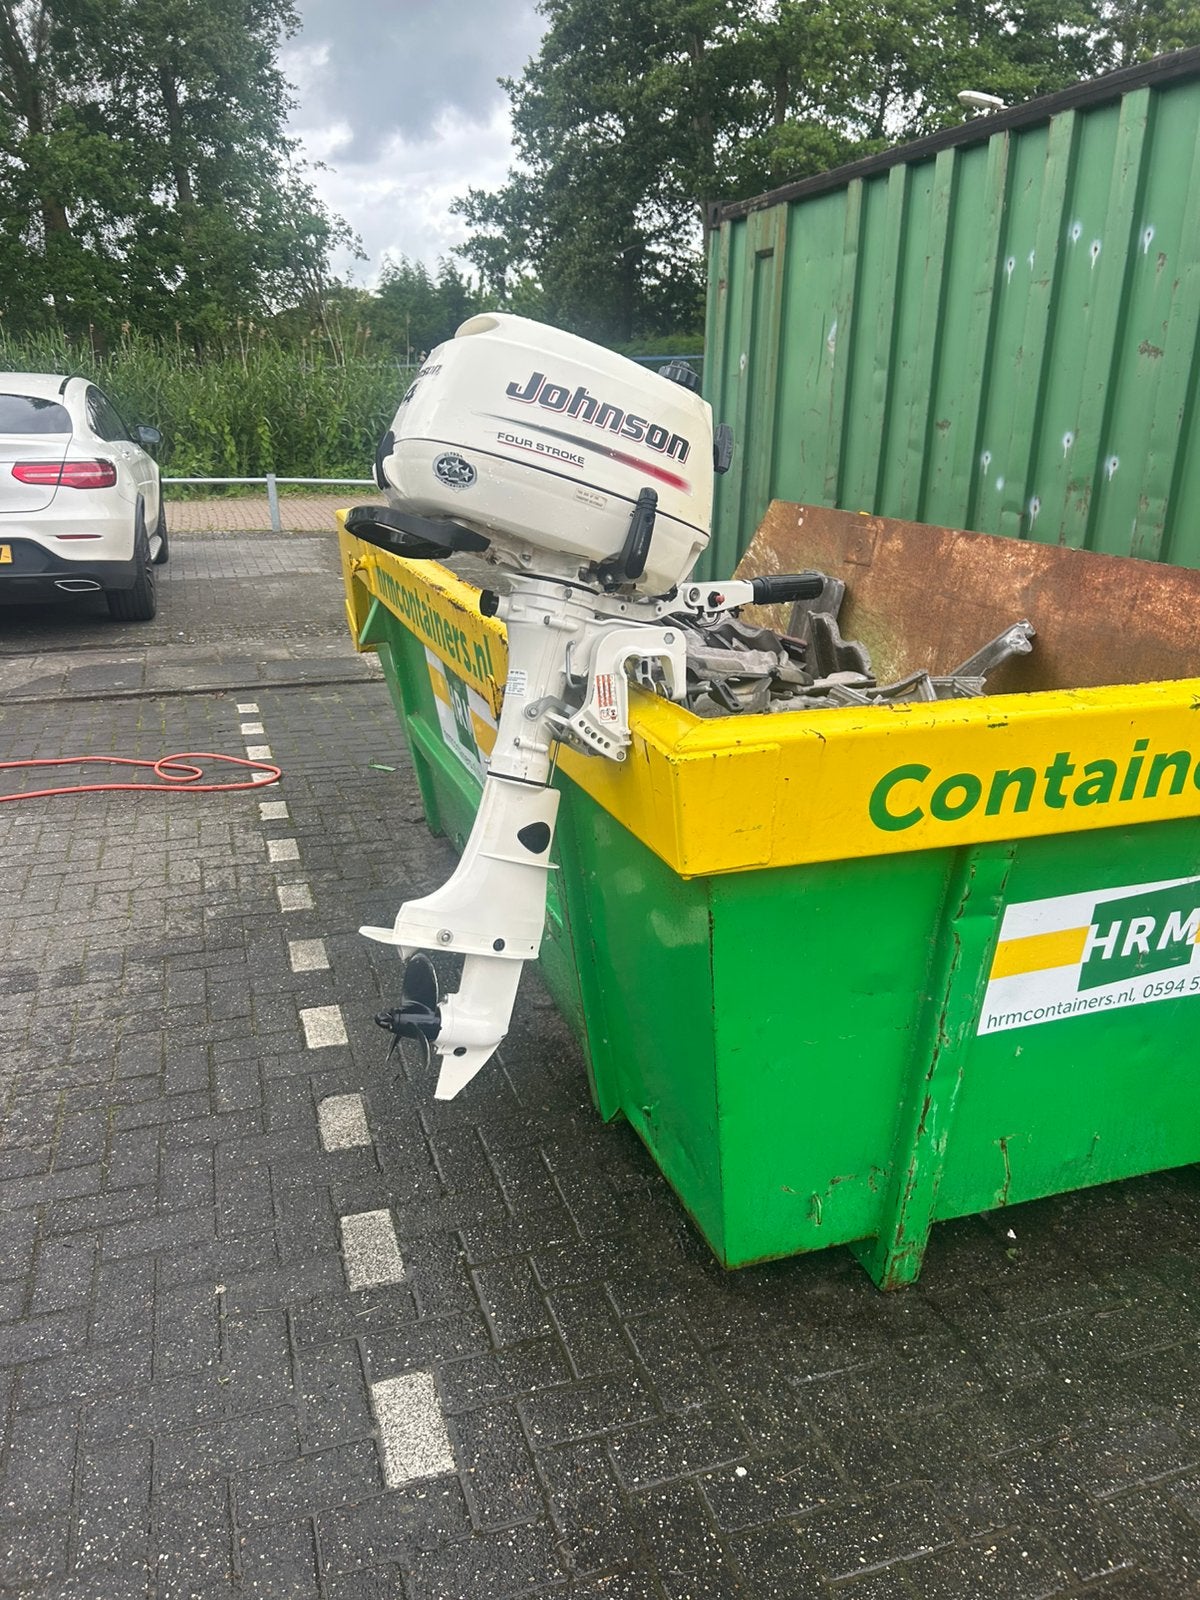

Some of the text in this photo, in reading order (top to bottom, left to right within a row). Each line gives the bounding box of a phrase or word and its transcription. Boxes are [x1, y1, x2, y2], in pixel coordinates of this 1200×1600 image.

[505, 371, 691, 464] Johnson
[497, 432, 585, 465] FOUR STROKE
[869, 738, 1200, 832] Contain
[1081, 907, 1200, 964] HRM
[987, 976, 1200, 1029] hrmcontainers.nl, 0594 5
